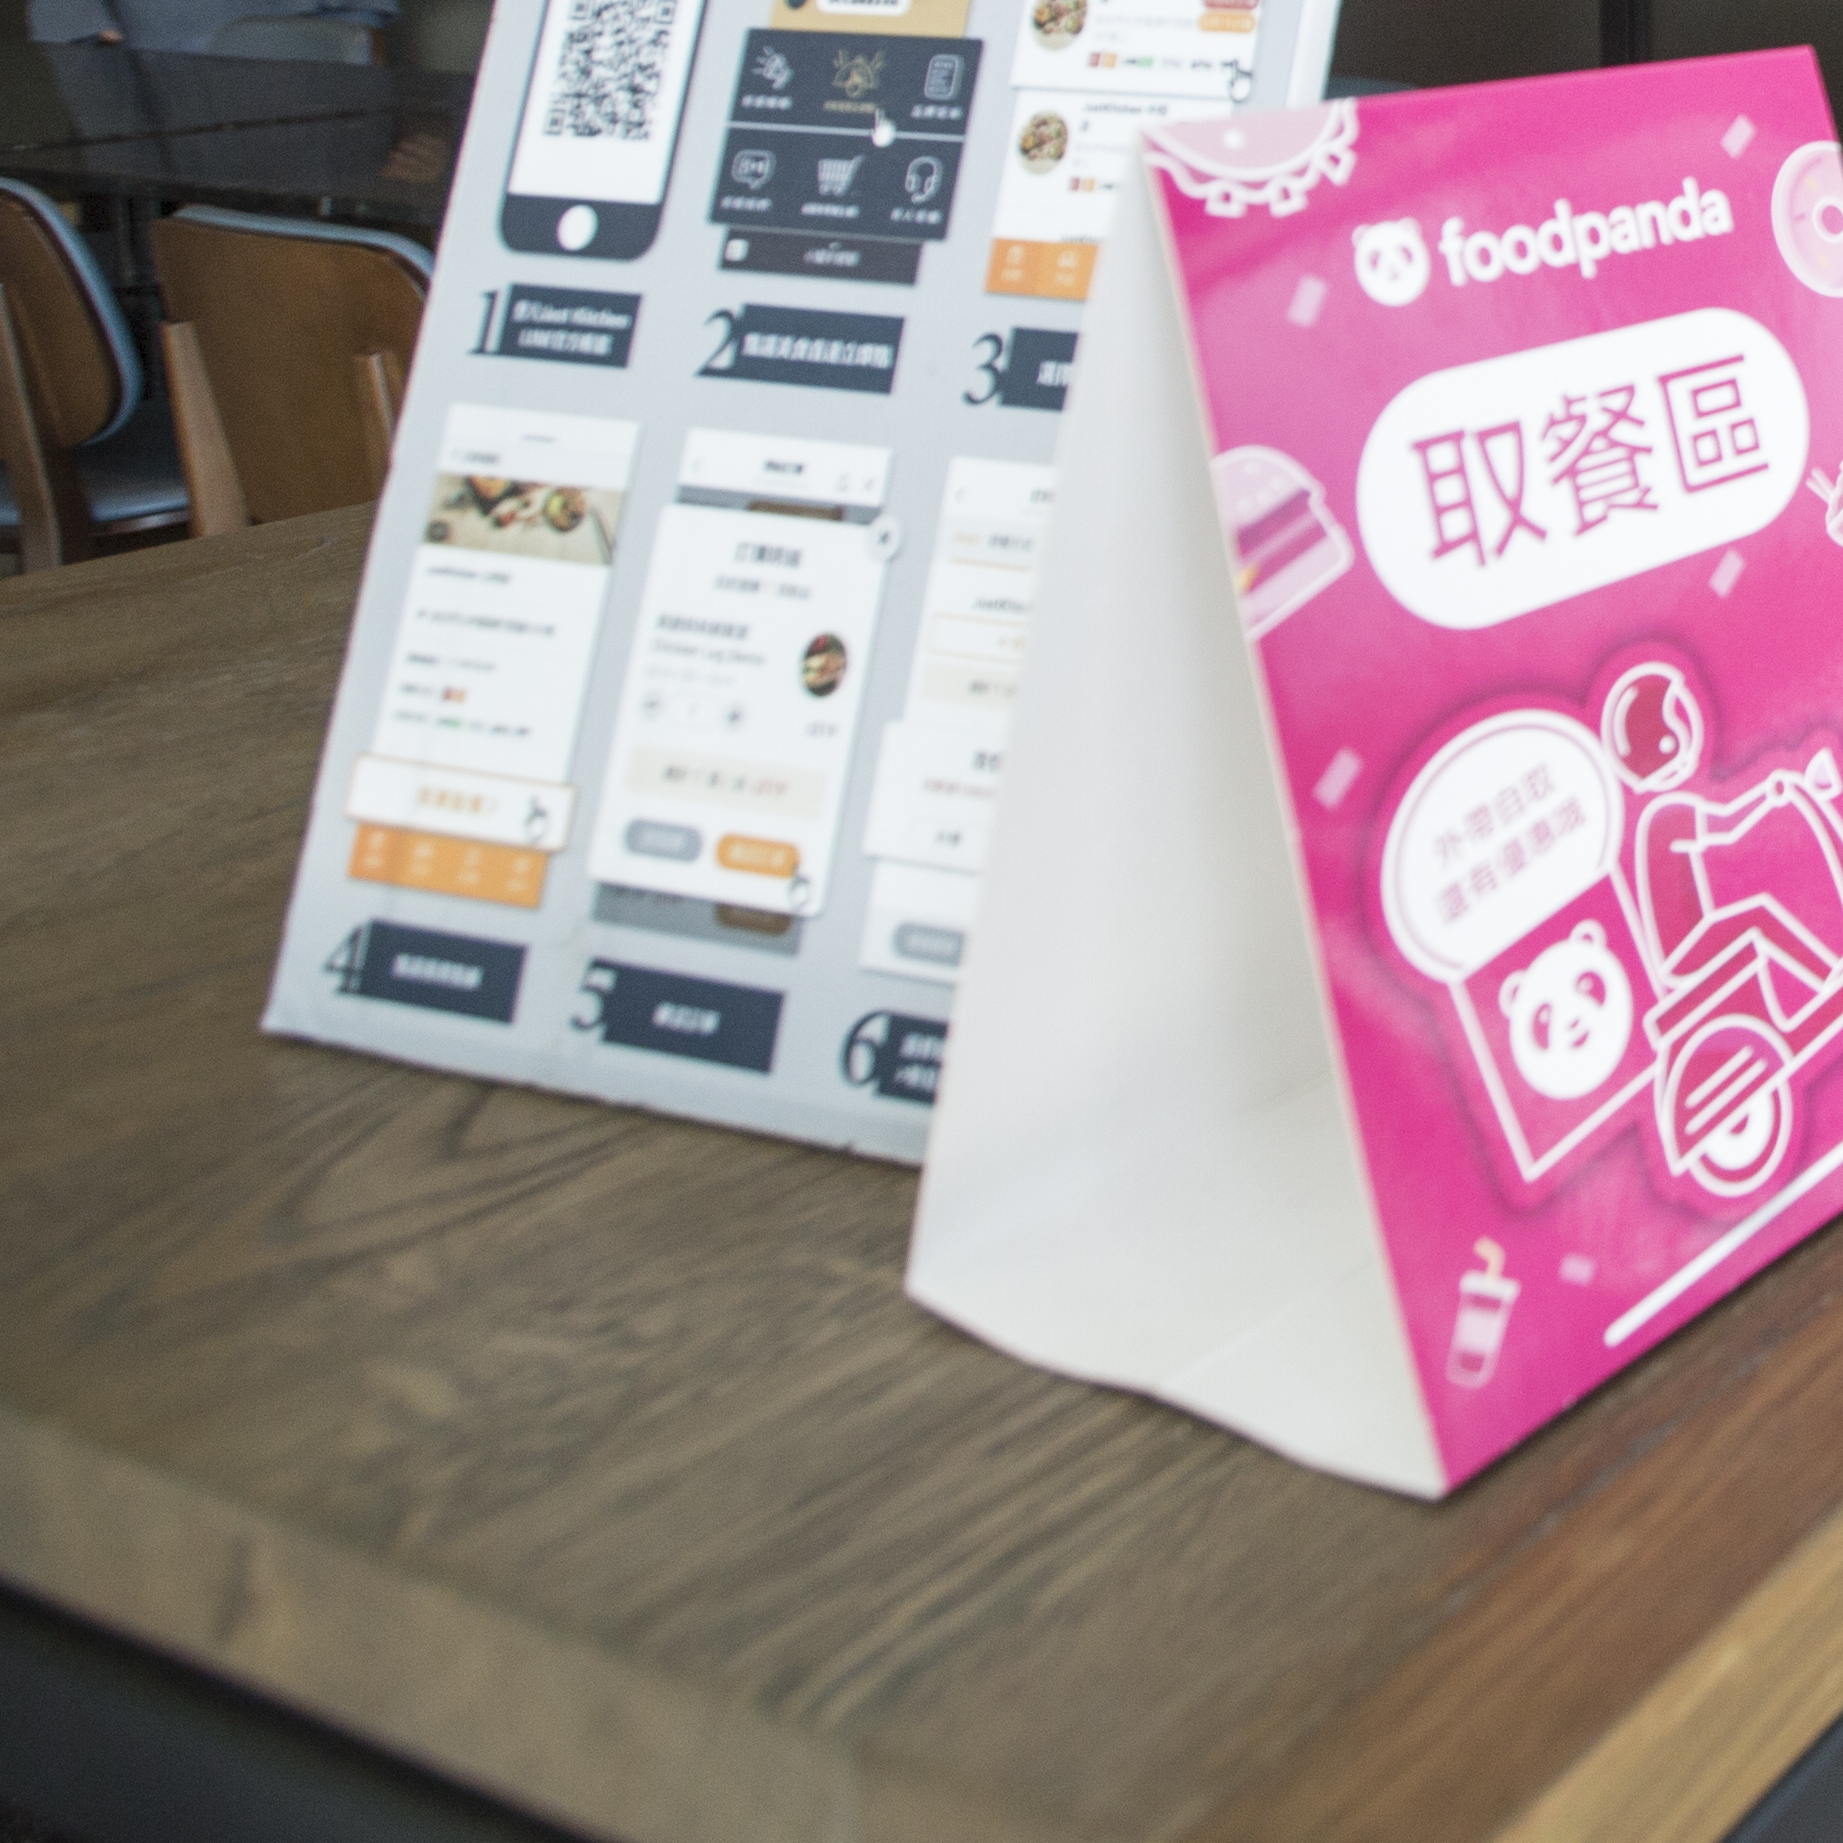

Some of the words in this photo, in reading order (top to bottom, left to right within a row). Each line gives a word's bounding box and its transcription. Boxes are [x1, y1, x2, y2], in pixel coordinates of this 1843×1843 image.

[1438, 175, 1735, 287] foodpanda
[469, 290, 499, 356] 1
[694, 309, 736, 377] 2
[961, 333, 1003, 404] 3
[1410, 353, 1771, 568] 取餐區
[1434, 761, 1556, 869] 外帶自取
[323, 925, 373, 995] 4
[571, 959, 616, 1032] 5
[840, 1007, 890, 1088] 6
